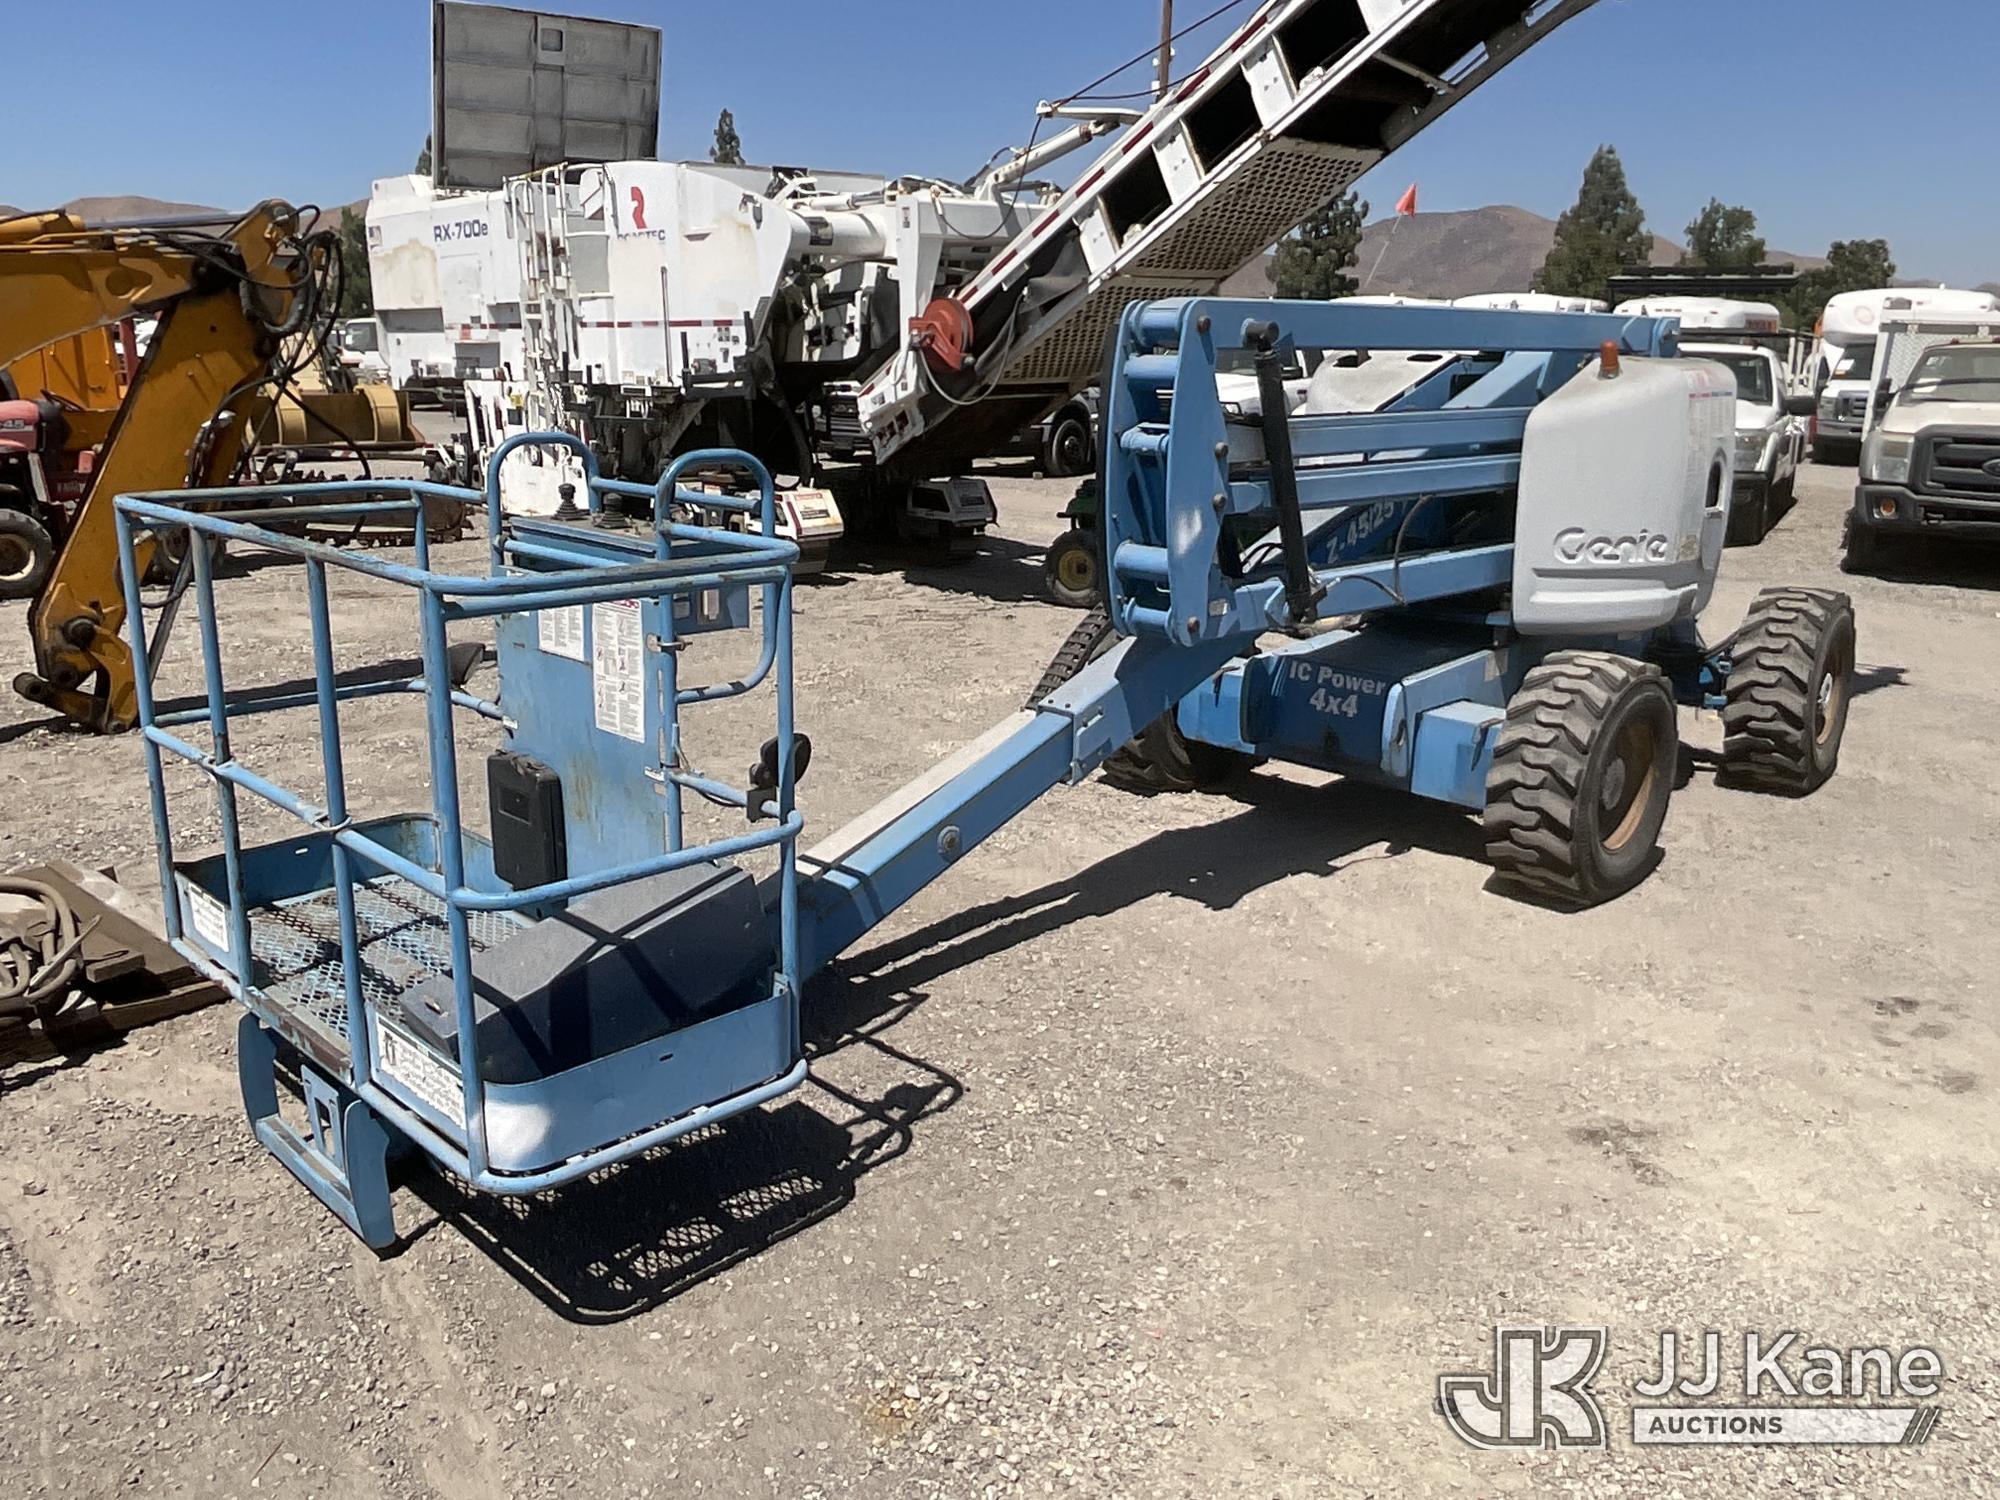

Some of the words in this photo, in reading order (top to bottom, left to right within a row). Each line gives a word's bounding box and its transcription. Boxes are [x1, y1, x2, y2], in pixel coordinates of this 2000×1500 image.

[1554, 526, 1667, 564] Genie
[1289, 660, 1312, 681] IC
[1317, 666, 1386, 695] Power
[1309, 687, 1358, 718] 4x4
